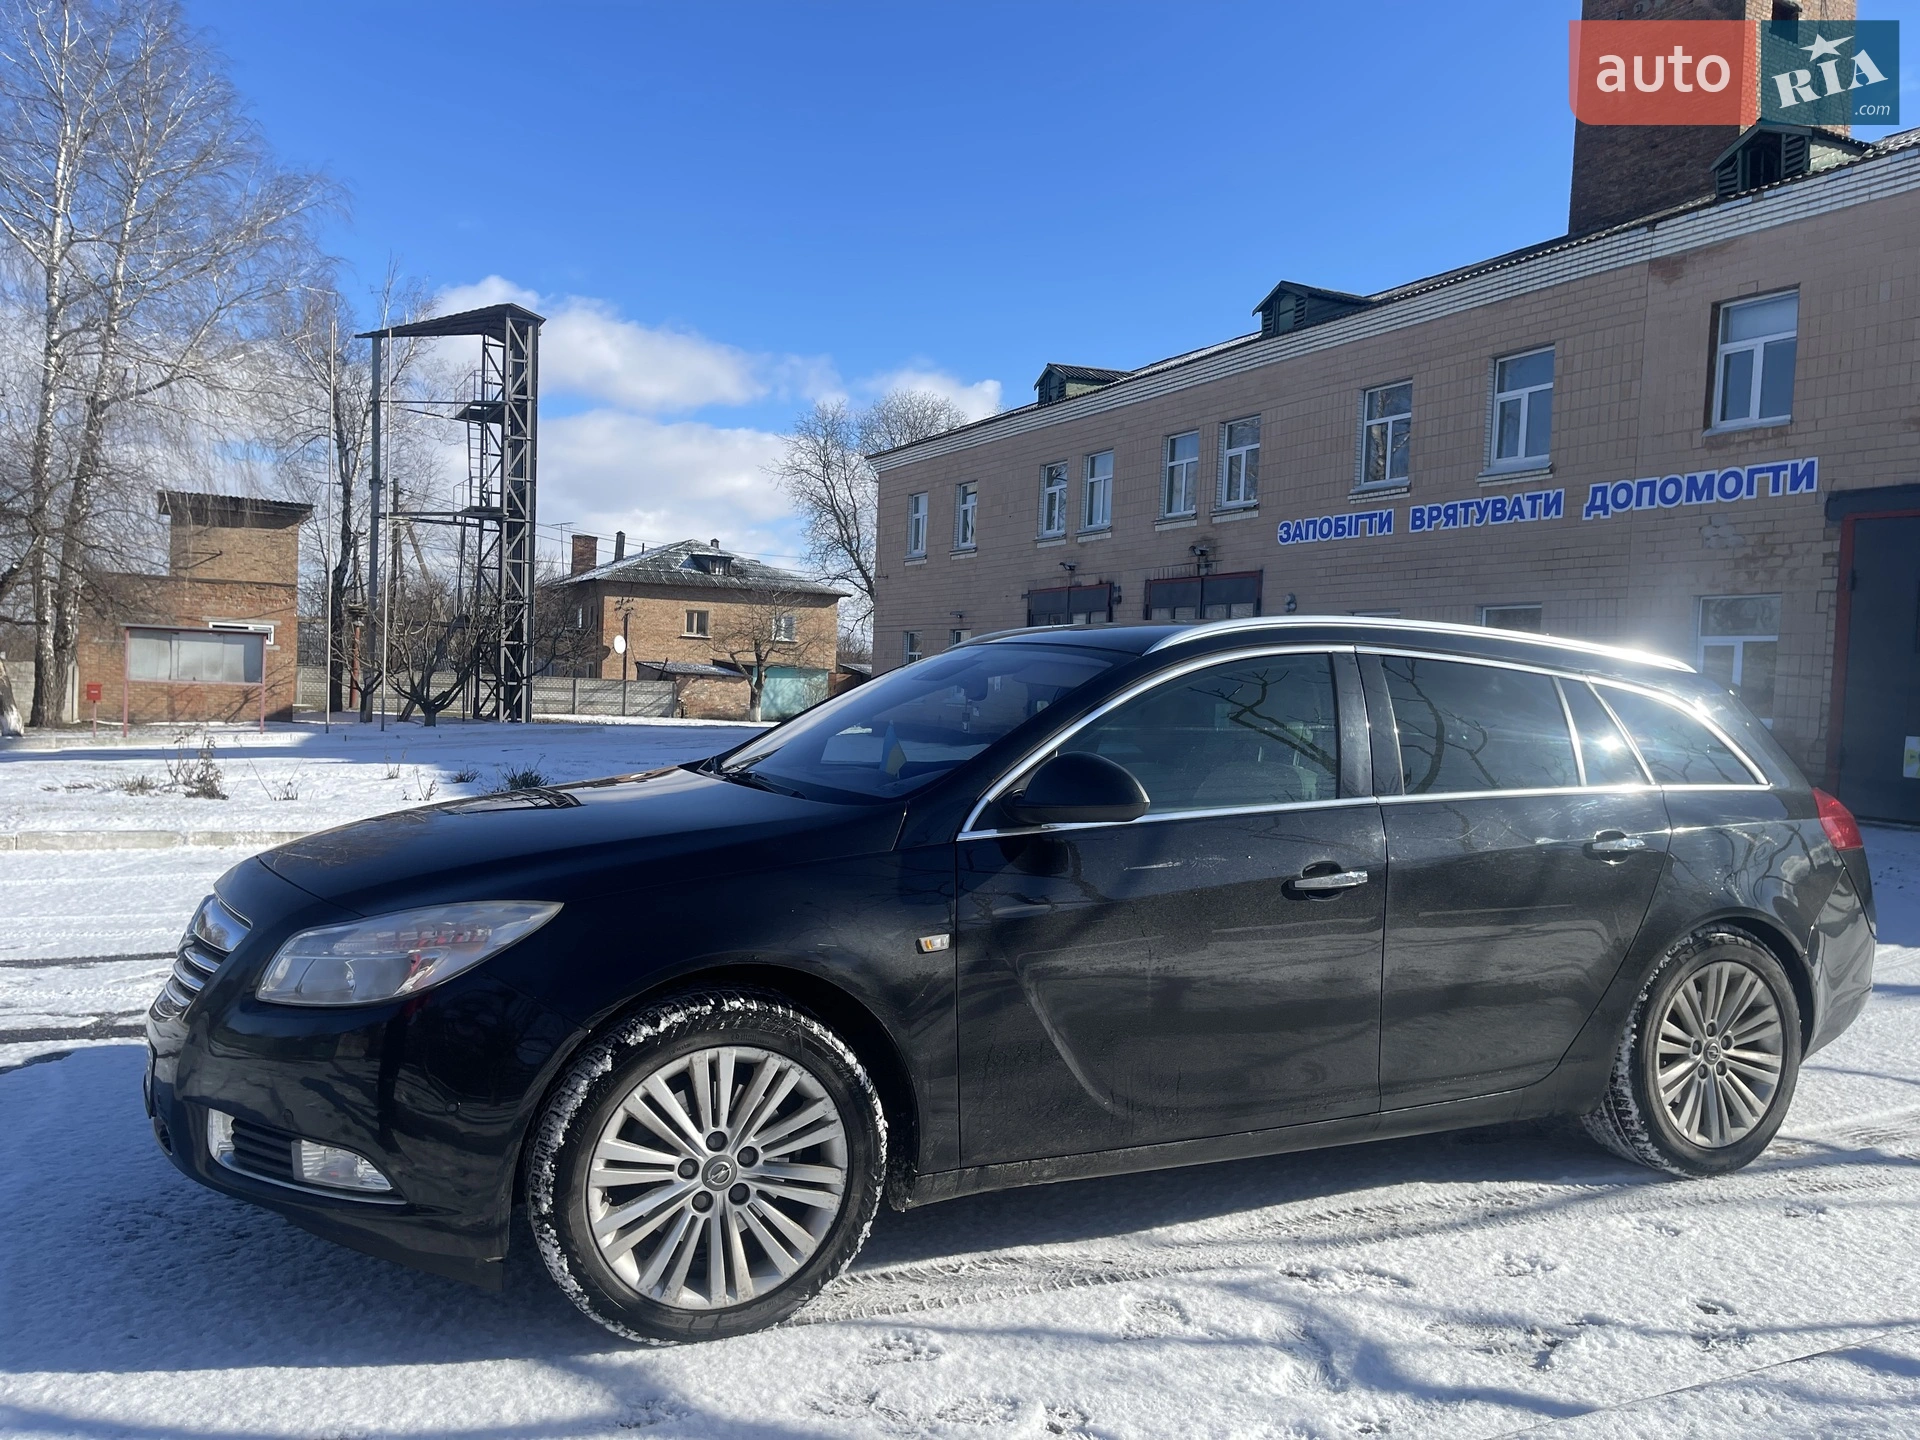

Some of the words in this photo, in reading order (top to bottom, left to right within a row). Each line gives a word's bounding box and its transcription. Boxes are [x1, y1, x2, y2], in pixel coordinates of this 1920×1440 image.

[1278, 510, 1394, 545] ЗАПОБІГТИ
[1410, 489, 1563, 533] ВРЯТУВАТИ
[1583, 459, 1818, 520] ДОПОМОГТИ
[1678, 935, 1752, 964] NEXEN
